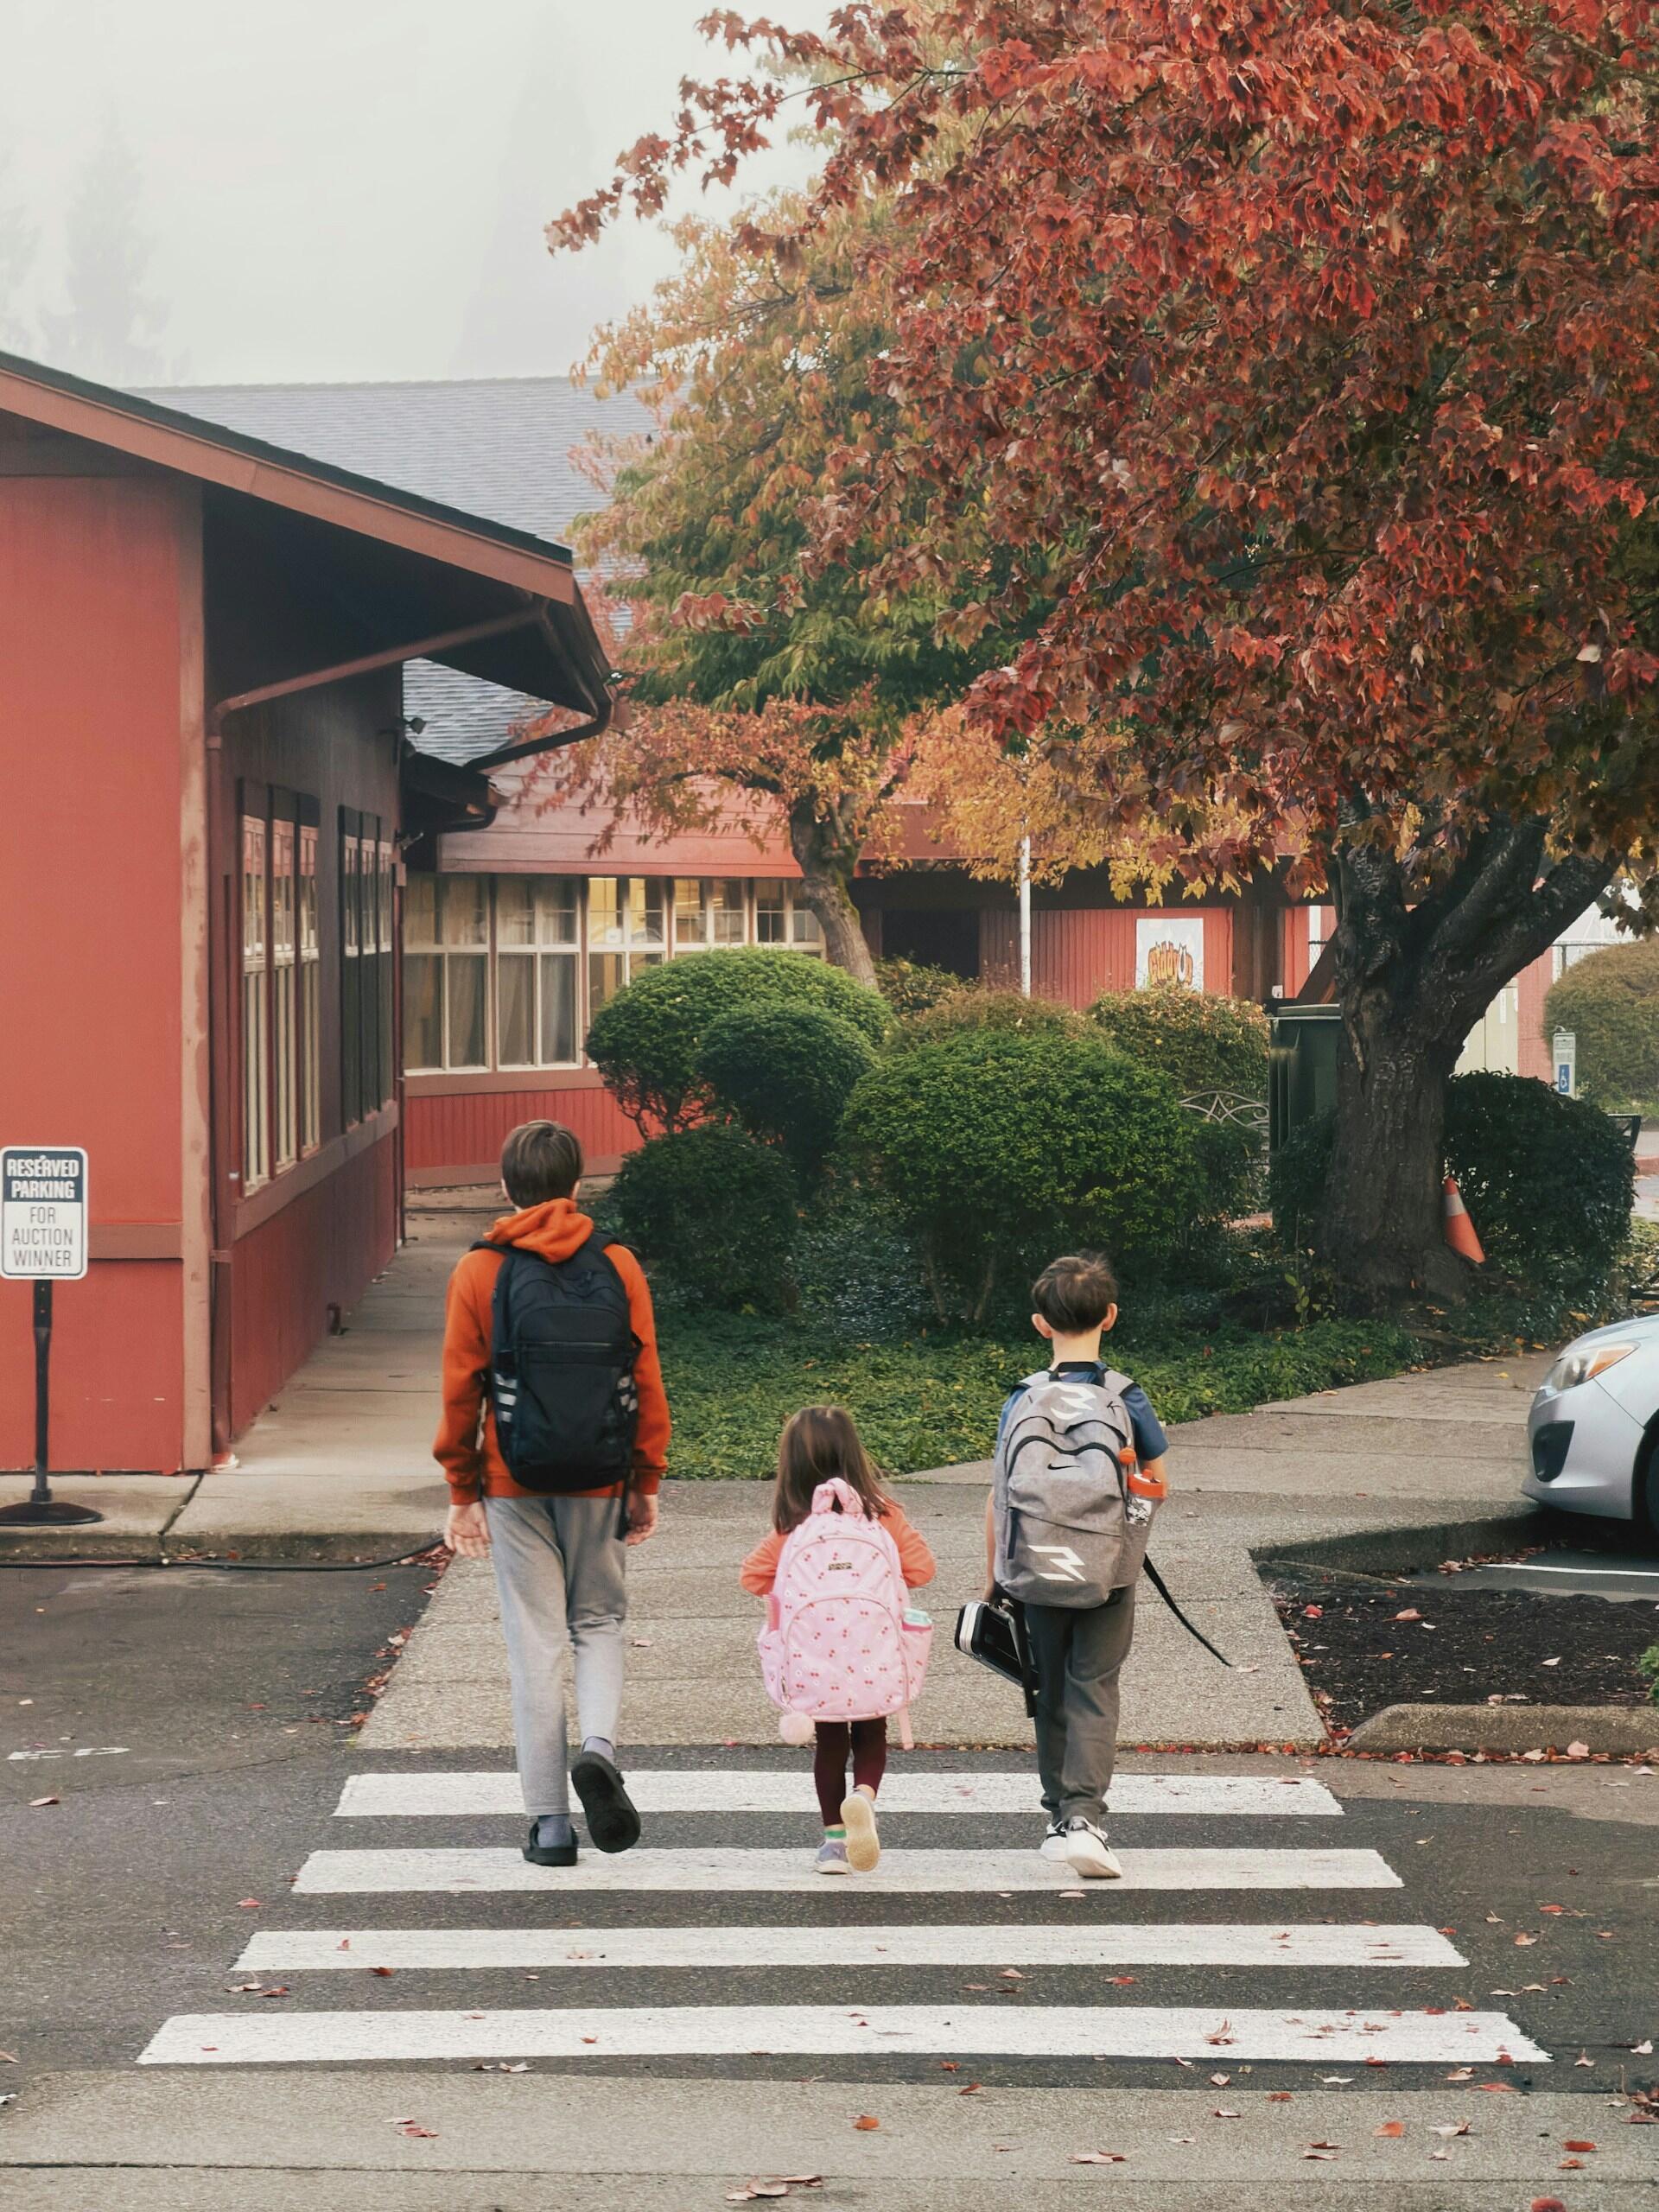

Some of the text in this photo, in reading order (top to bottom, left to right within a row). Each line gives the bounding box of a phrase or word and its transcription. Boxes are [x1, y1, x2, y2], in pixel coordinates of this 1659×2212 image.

[7, 1159, 79, 1177] RESERVED
[11, 1180, 75, 1198] PARKING
[30, 1207, 56, 1224] FOR
[13, 1229, 73, 1245] AUCTION
[14, 1250, 71, 1267] WINNER
